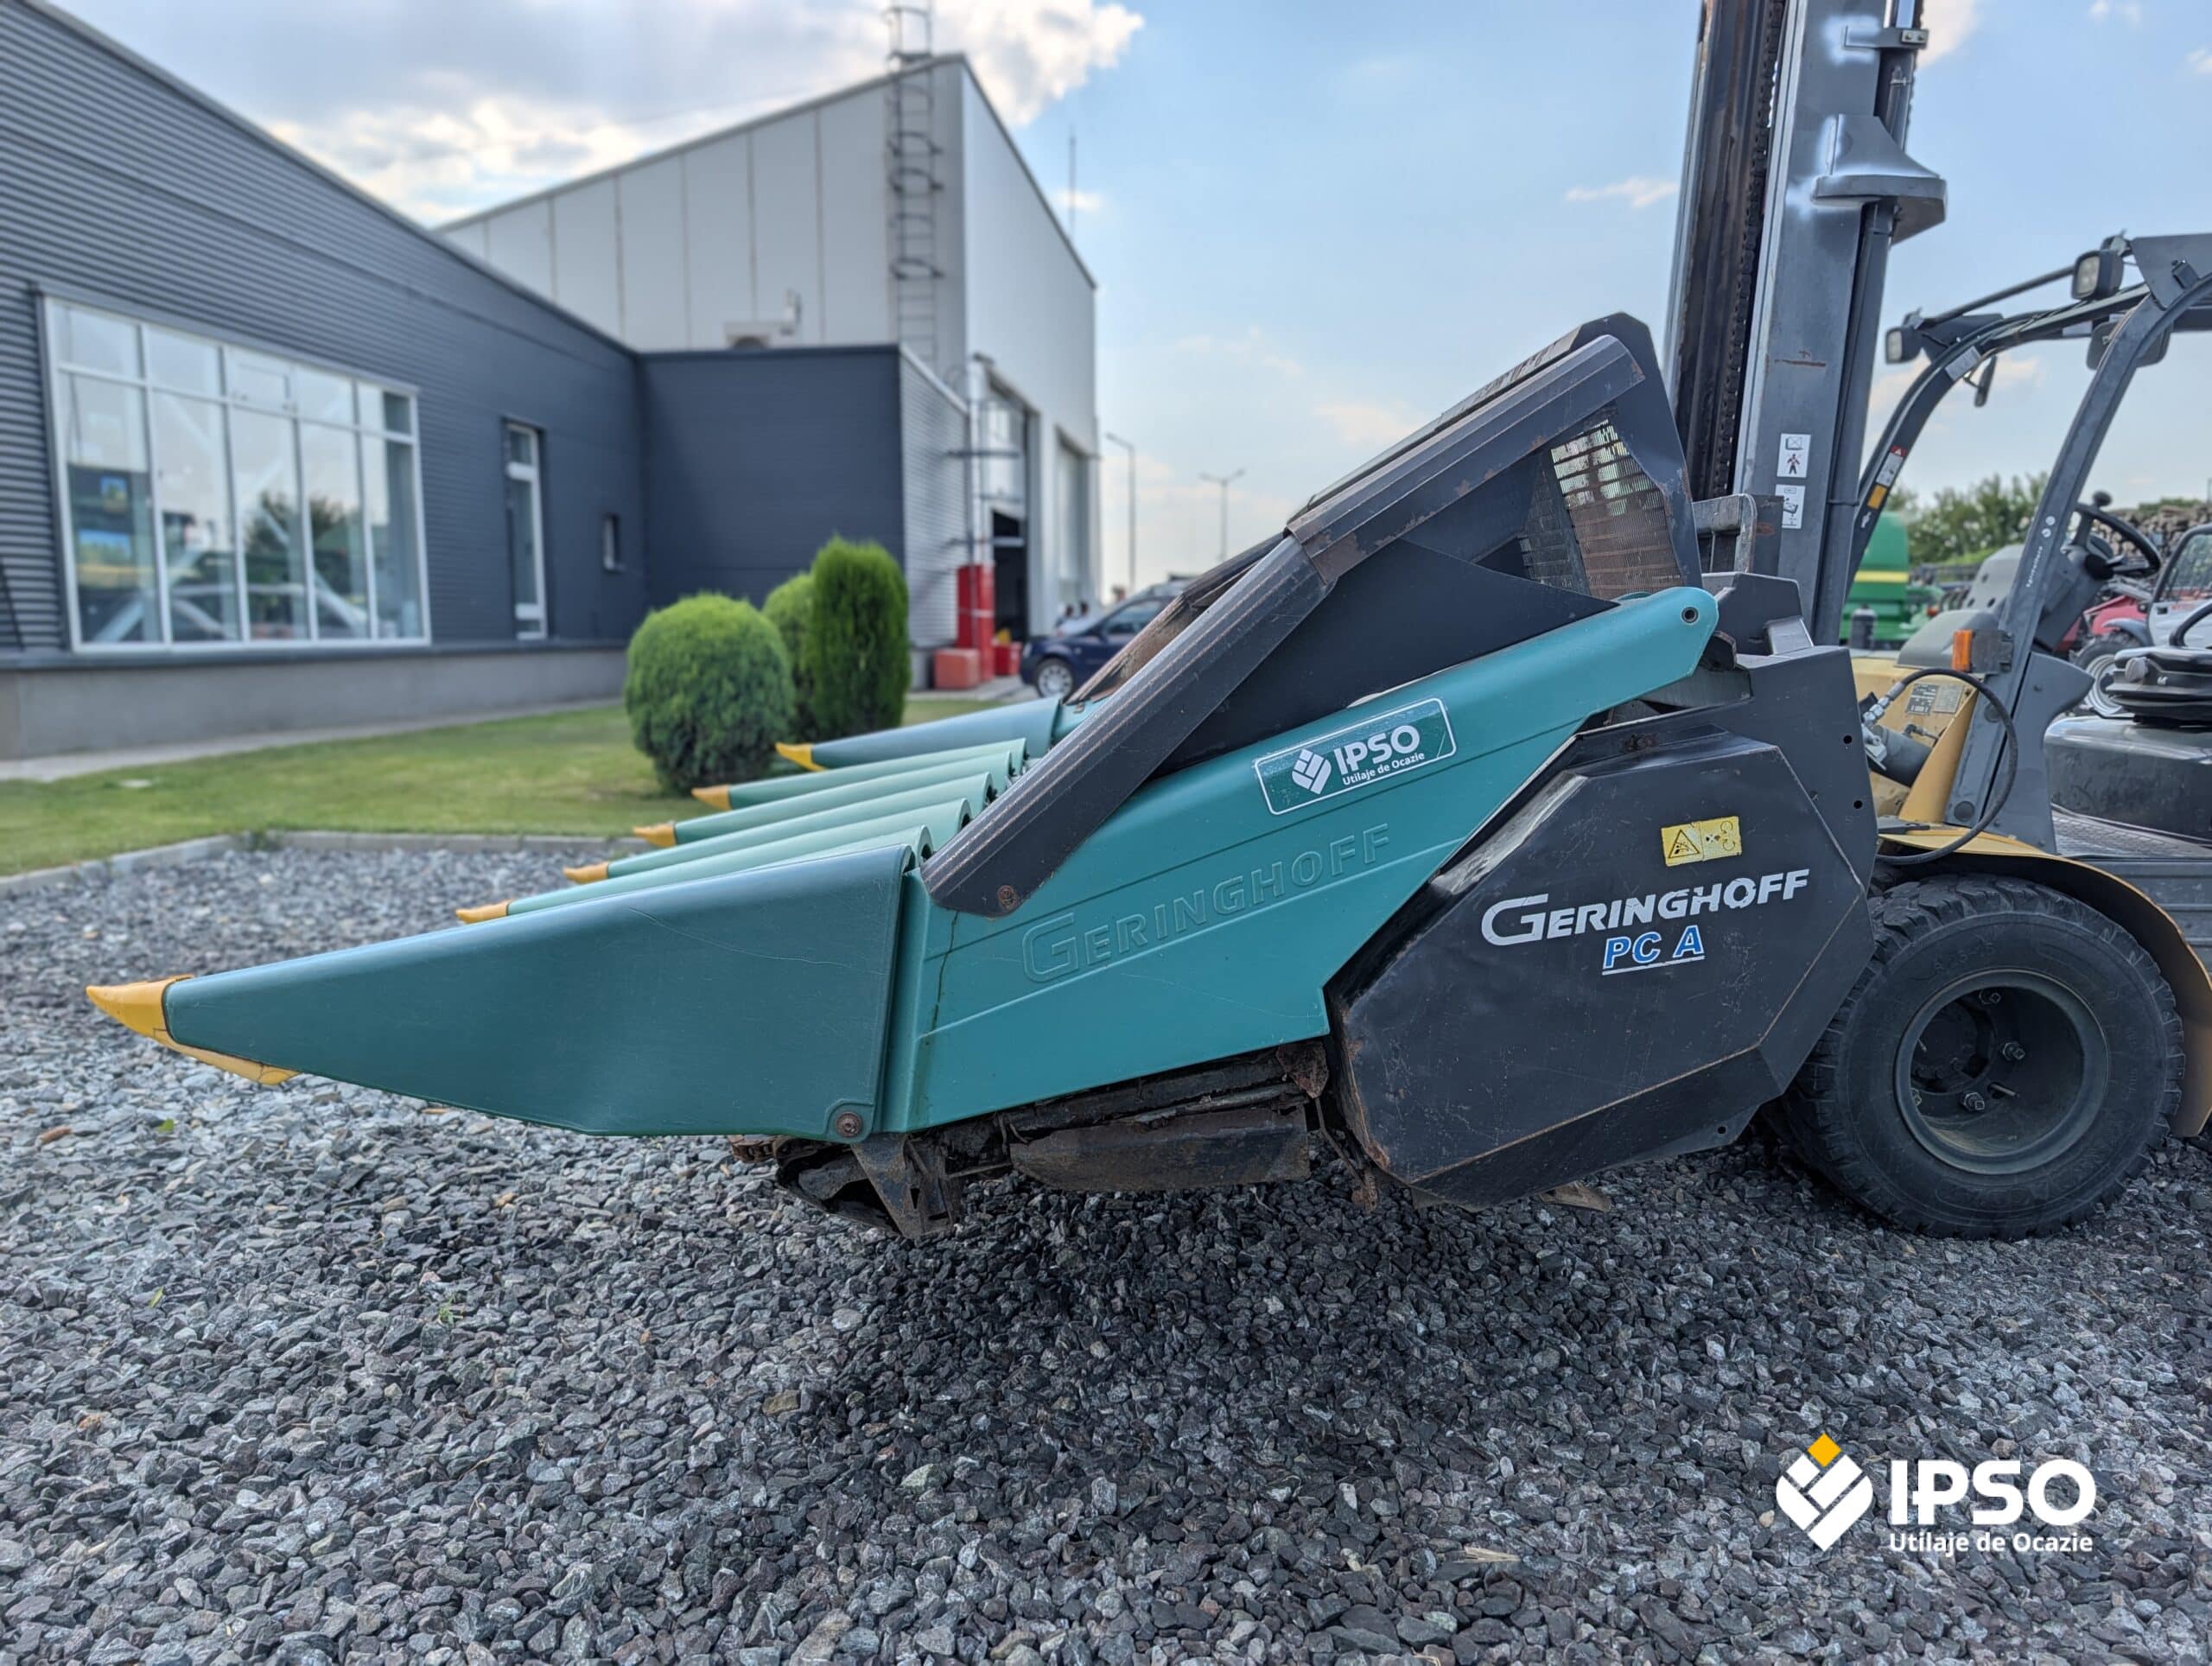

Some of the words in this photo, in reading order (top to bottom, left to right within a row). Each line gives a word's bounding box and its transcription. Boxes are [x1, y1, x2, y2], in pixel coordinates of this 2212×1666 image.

[1333, 725, 1420, 775] IPSO
[1342, 768, 1376, 785] Utilaje
[1377, 765, 1390, 773] de
[1392, 752, 1425, 769] Ocazie
[1022, 823, 1389, 982] GERINGHOFF
[1481, 868, 1810, 946] GERINGHOFF
[1603, 932, 1662, 969] PC
[1673, 925, 1705, 958] A
